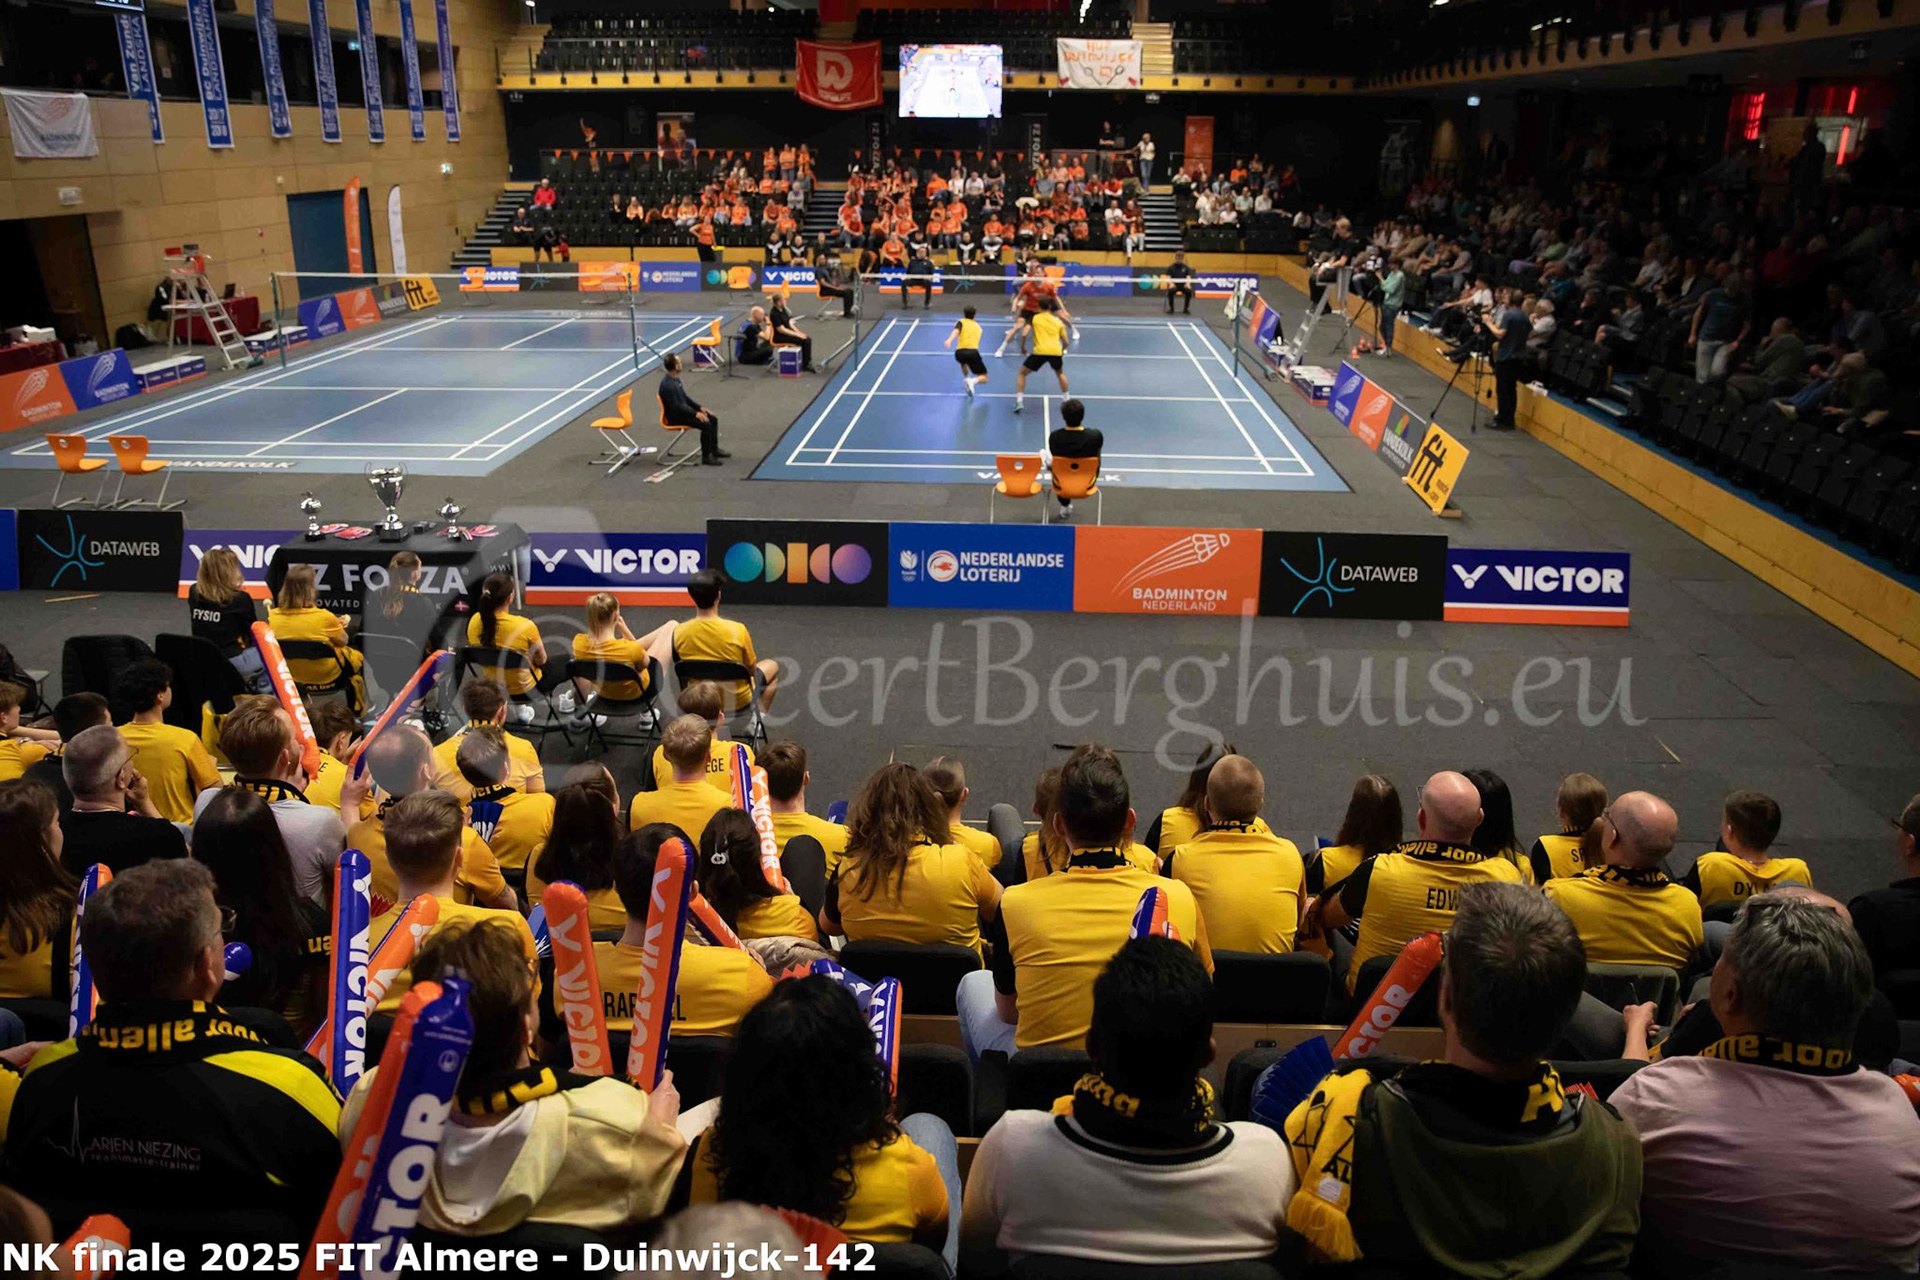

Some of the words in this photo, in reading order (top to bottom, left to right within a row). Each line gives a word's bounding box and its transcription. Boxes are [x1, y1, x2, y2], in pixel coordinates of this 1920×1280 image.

[128, 63, 141, 93] Van
[90, 541, 160, 557] DATAWEB
[574, 548, 701, 575] VICTOR
[959, 551, 1065, 568] NEDERLANDSE
[341, 563, 468, 596] FOZA
[959, 567, 1022, 583] LOTERIJ
[1340, 564, 1419, 583] DATAWEB
[1494, 564, 1625, 594] VICTOR
[1132, 587, 1228, 602] BADMINTON
[1142, 600, 1217, 612] NEDERLAND
[192, 608, 221, 623] FYSIO
[277, 658, 316, 741] VICTOR
[750, 794, 781, 870] VICTOR
[344, 926, 370, 1078] VICTOR
[628, 922, 663, 1078] VICTOR
